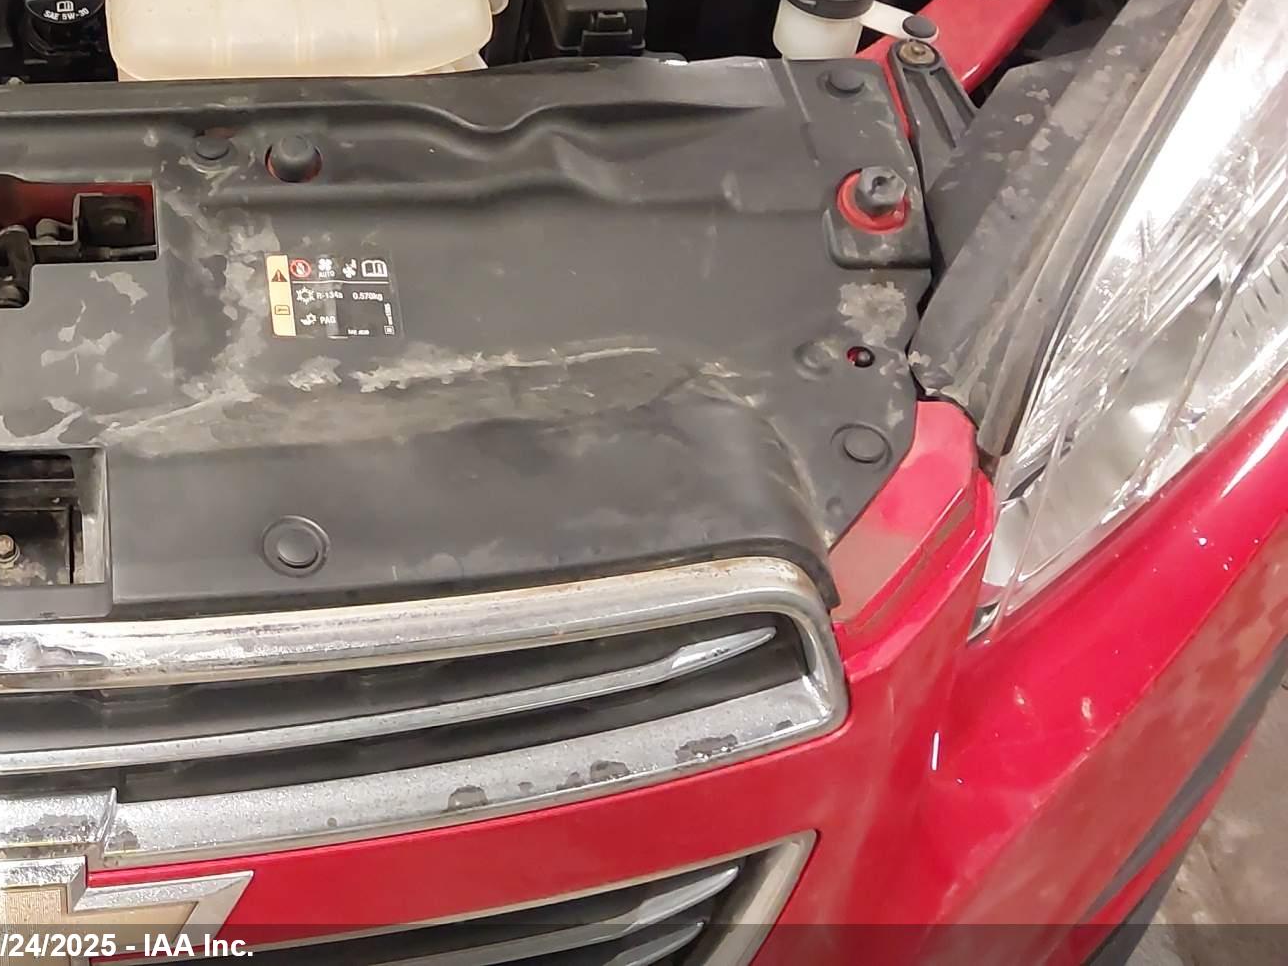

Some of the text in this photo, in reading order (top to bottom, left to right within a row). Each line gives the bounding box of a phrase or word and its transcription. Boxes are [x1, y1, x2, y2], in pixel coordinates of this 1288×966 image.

[43, 7, 90, 21] SAE 5W-30
[318, 270, 336, 279] AUTO
[316, 291, 344, 300] R-134a
